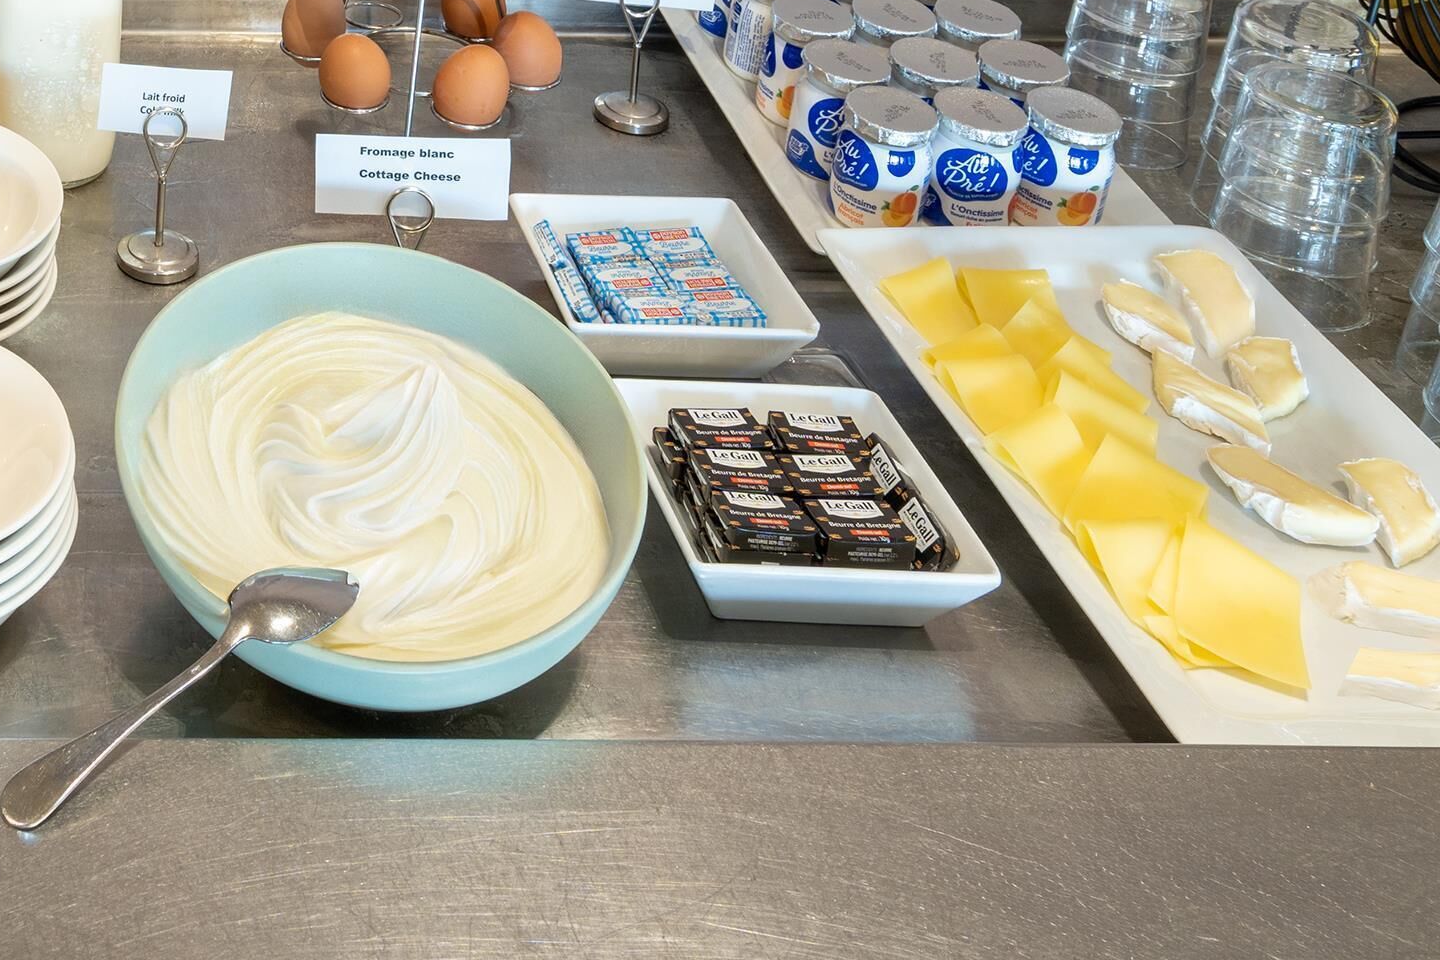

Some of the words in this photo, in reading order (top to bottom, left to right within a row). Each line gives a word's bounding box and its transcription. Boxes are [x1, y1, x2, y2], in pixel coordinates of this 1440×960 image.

[142, 92, 160, 102] Lait
[162, 93, 186, 103] froid
[140, 105, 161, 116] Col
[360, 146, 415, 159] Fromage
[419, 149, 455, 159] blanc
[840, 139, 861, 159] Au
[947, 153, 989, 174] Au
[359, 169, 409, 182] Cottage
[414, 171, 461, 182] Cheese
[951, 203, 1004, 217] L'Onctissime
[693, 411, 710, 419] Le
[711, 411, 739, 419] Gall
[789, 413, 806, 421] Le
[807, 414, 836, 425] Gall
[825, 435, 858, 443] Bretagne
[710, 451, 729, 459] Le
[730, 452, 759, 461] Gall
[799, 457, 816, 465] Le
[818, 457, 847, 465] Gall
[871, 448, 883, 468] Le
[880, 461, 897, 486] Gall
[748, 472, 782, 480] Bretagne
[728, 491, 746, 499] Le
[748, 492, 777, 501] Gall
[825, 501, 843, 510] Le
[845, 501, 875, 511] Gall
[767, 512, 801, 520] Bretagne
[866, 522, 901, 530] Bretagne
[907, 502, 918, 520] Le
[915, 517, 935, 543] Gall
